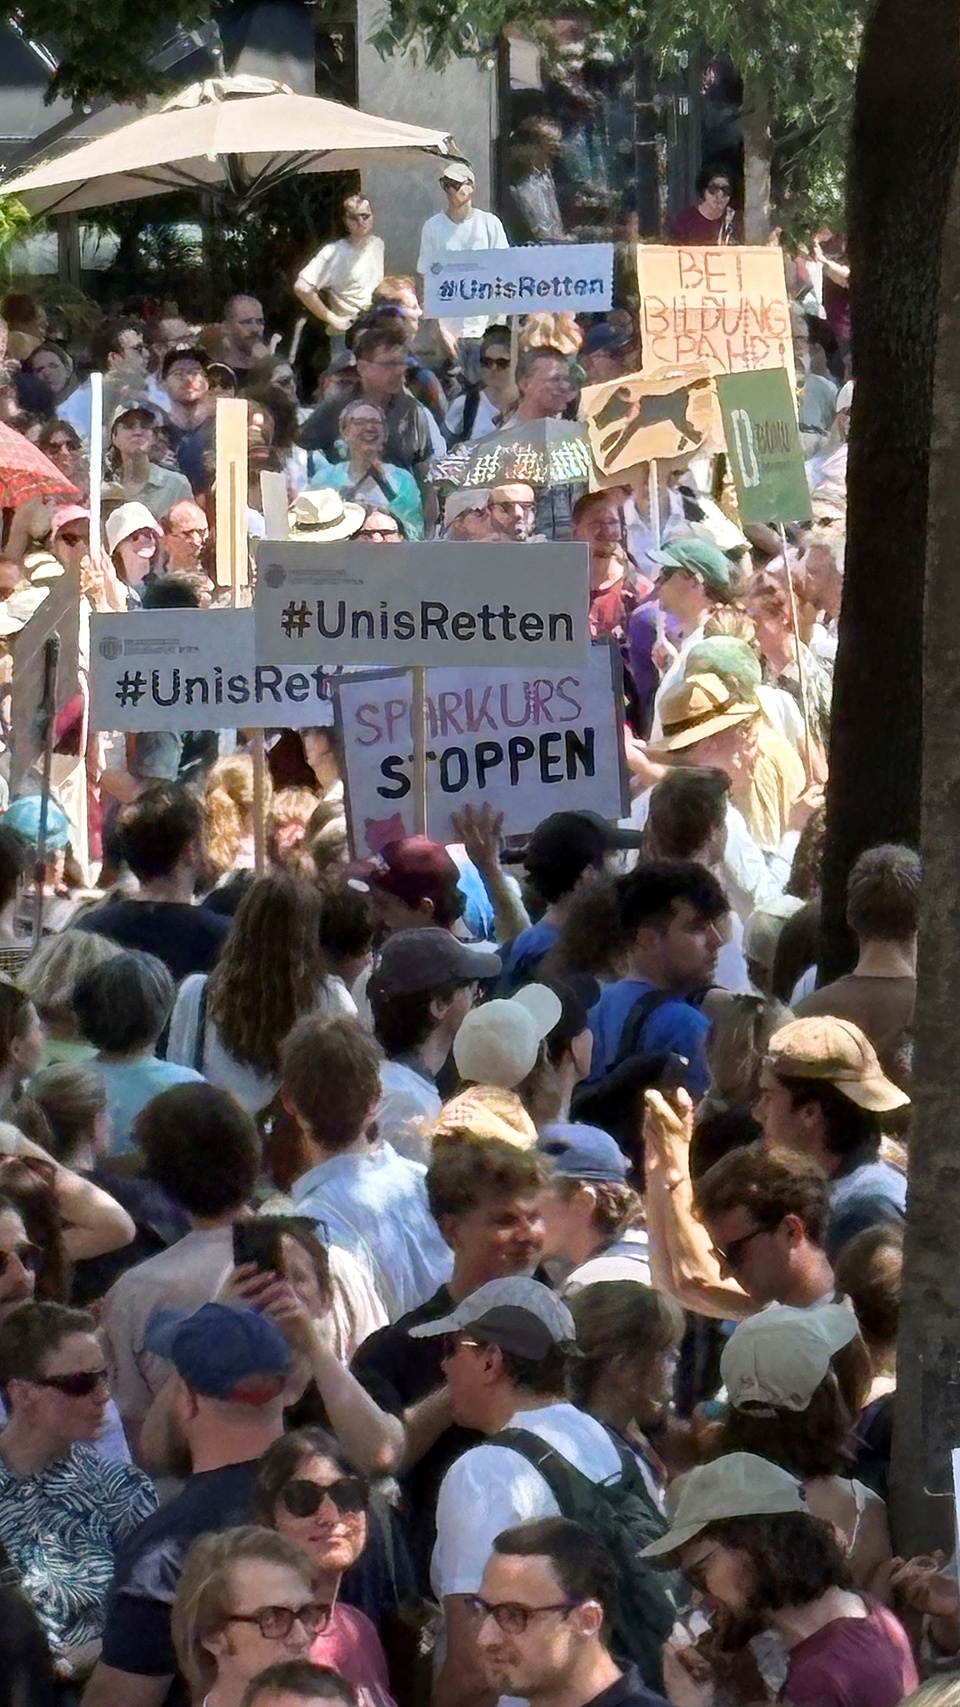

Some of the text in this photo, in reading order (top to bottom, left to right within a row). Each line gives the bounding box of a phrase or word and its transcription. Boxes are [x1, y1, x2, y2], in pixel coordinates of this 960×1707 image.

[439, 276, 604, 301] #UnisRetten
[644, 294, 787, 336] BILDUNG
[281, 600, 574, 641] #UnisRetten
